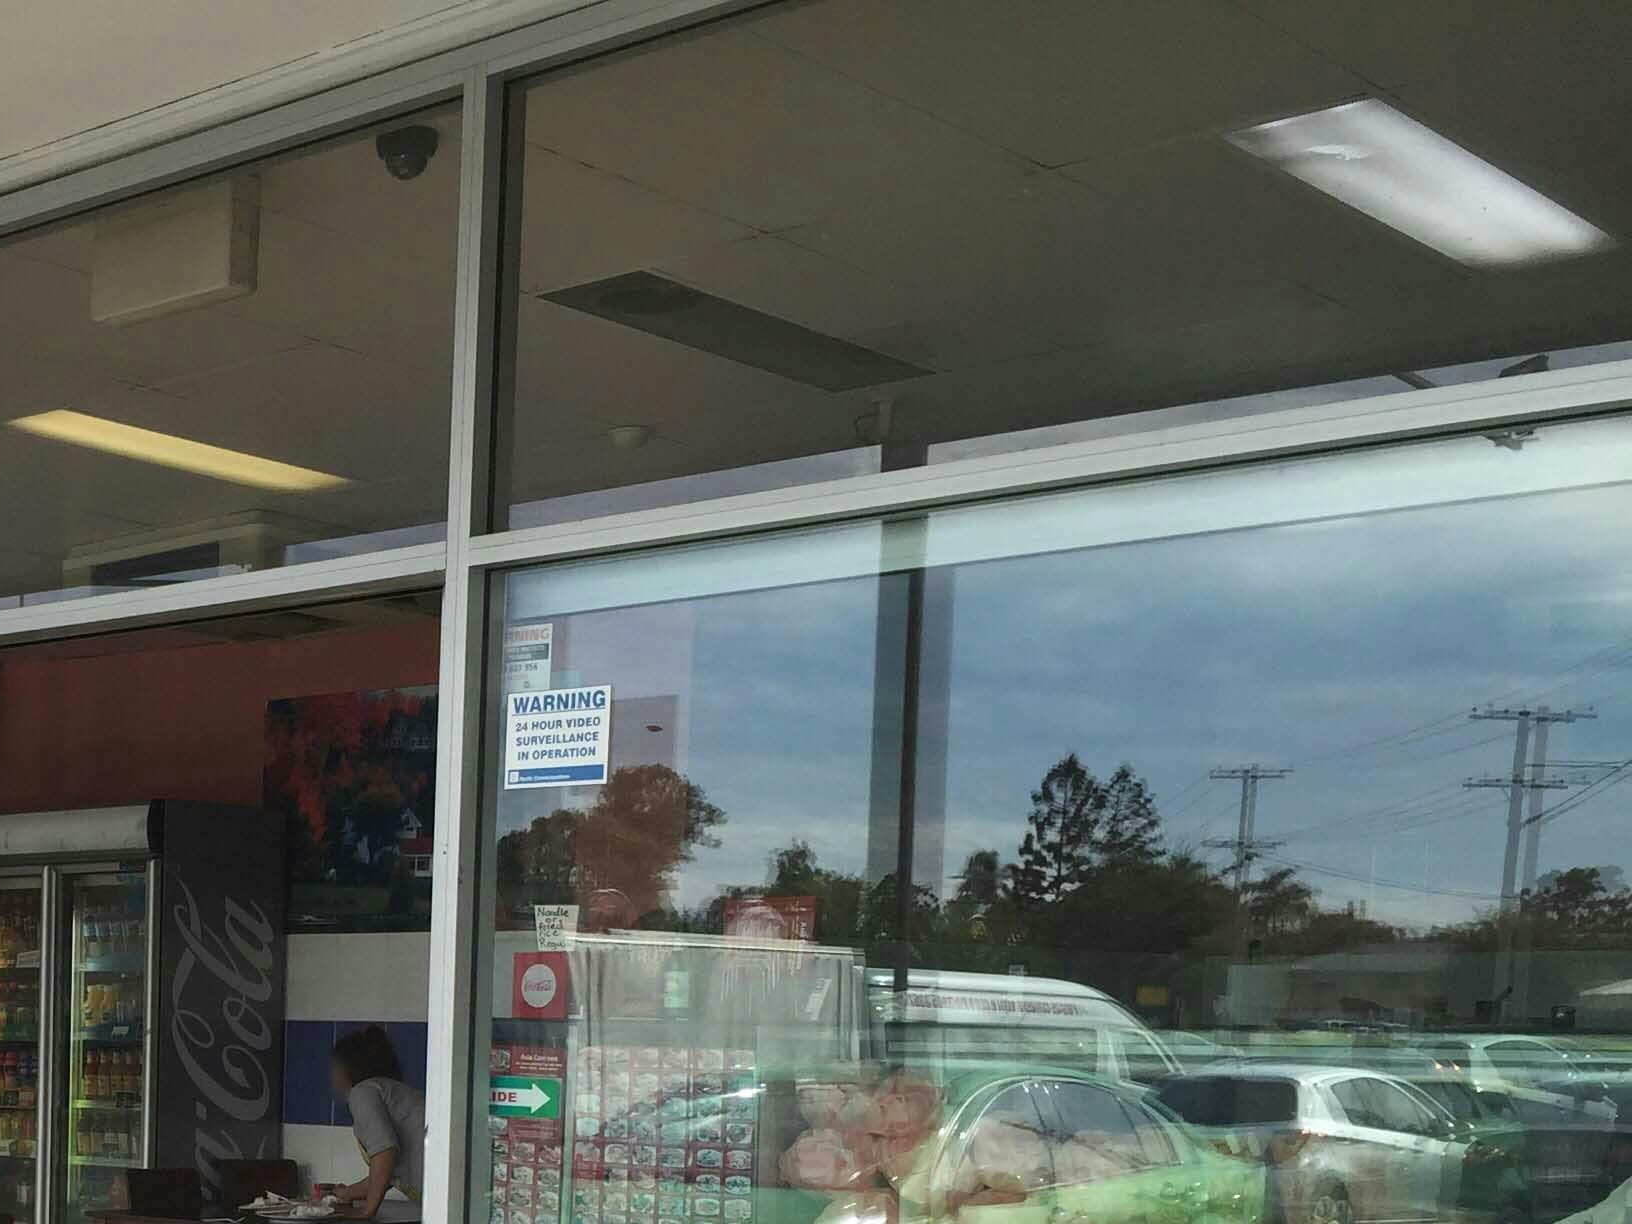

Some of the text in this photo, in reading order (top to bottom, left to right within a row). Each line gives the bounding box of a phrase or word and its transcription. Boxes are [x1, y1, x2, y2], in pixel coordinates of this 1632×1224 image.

[513, 689, 606, 714] WARNING
[515, 716, 601, 732] 24 HOUR VIDEO
[516, 731, 600, 747] SURVEILLANCE
[517, 746, 596, 760] IN OPERATION
[537, 906, 569, 917] Noodle
